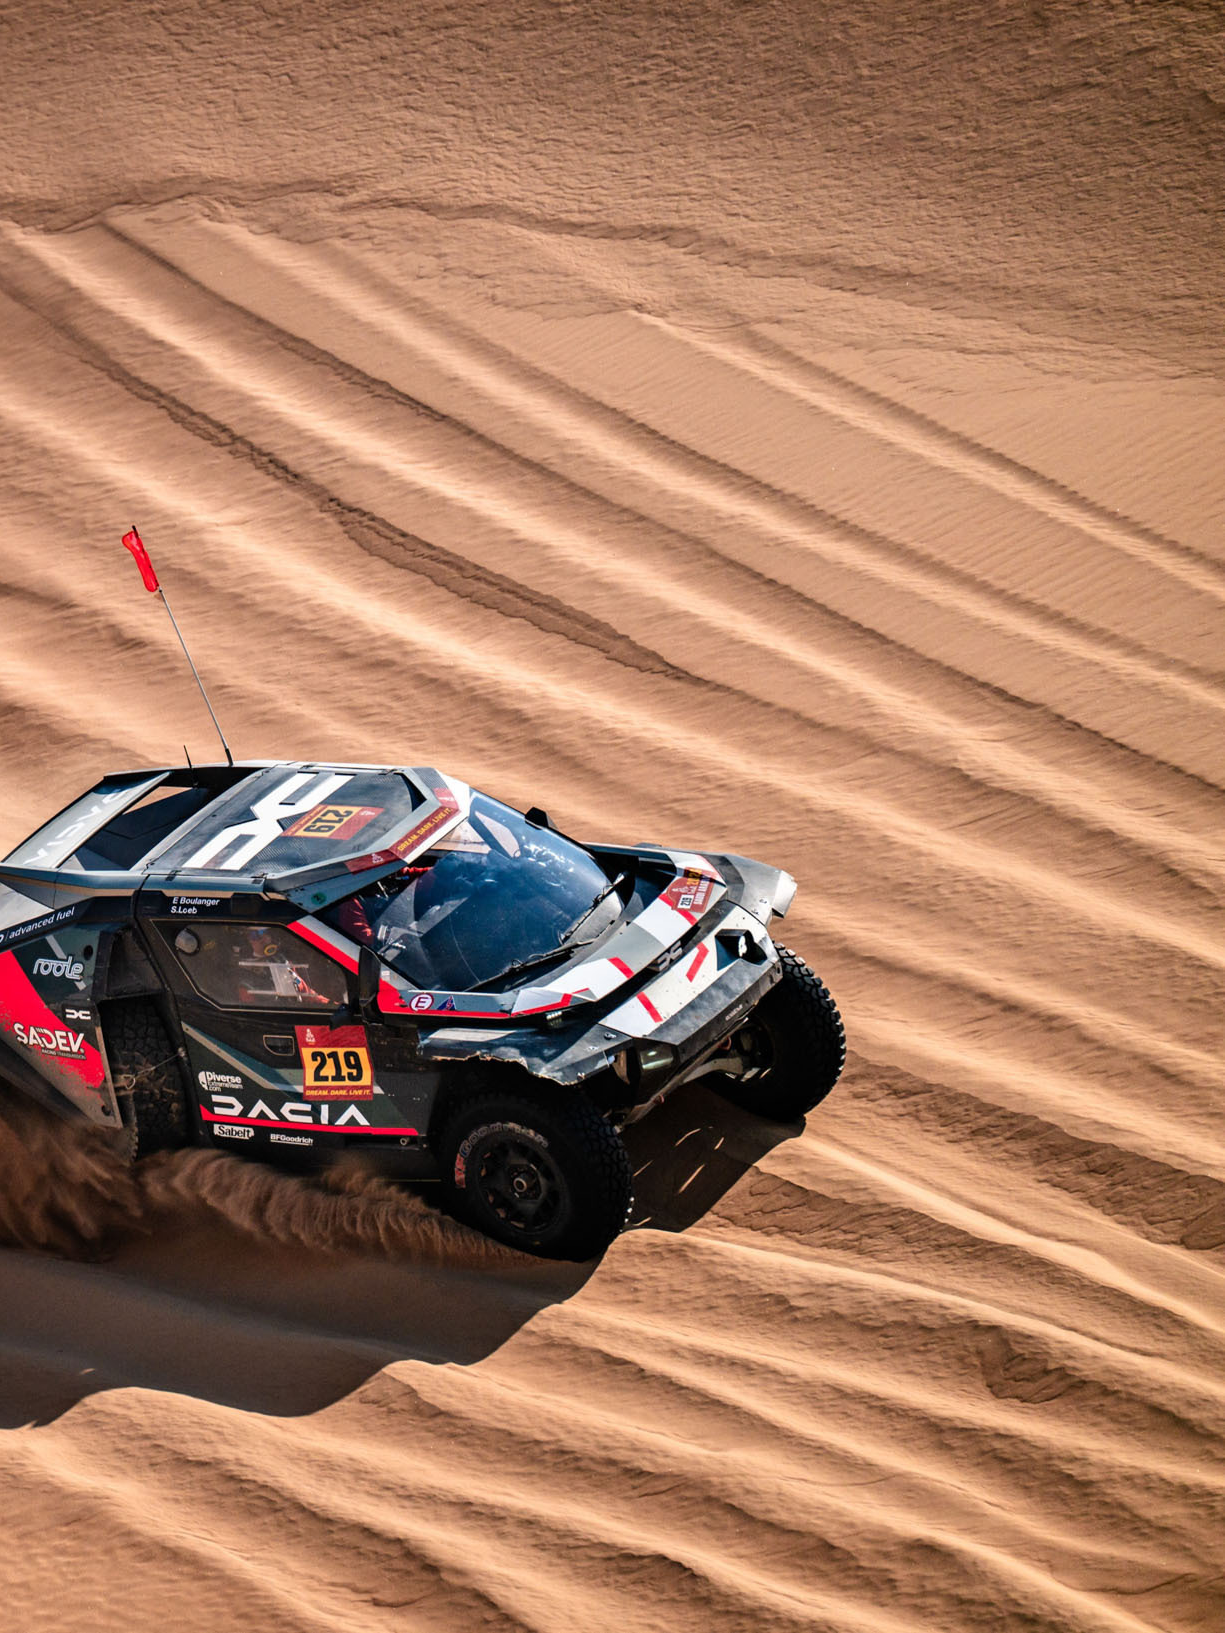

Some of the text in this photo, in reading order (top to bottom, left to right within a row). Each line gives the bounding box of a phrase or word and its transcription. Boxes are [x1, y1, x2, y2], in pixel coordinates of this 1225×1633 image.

[303, 809, 354, 833] 219
[170, 905, 198, 914] S.Loeb
[172, 896, 221, 907] E Boulanger
[8, 914, 55, 940] advanced
[56, 906, 75, 921] fuel
[33, 955, 84, 980] roole
[311, 1050, 363, 1082] 219
[205, 1071, 242, 1084] Diverse
[211, 1094, 371, 1126] DACIA
[218, 1124, 252, 1138] Sabelt
[270, 1133, 314, 1144] BFGoodrich
